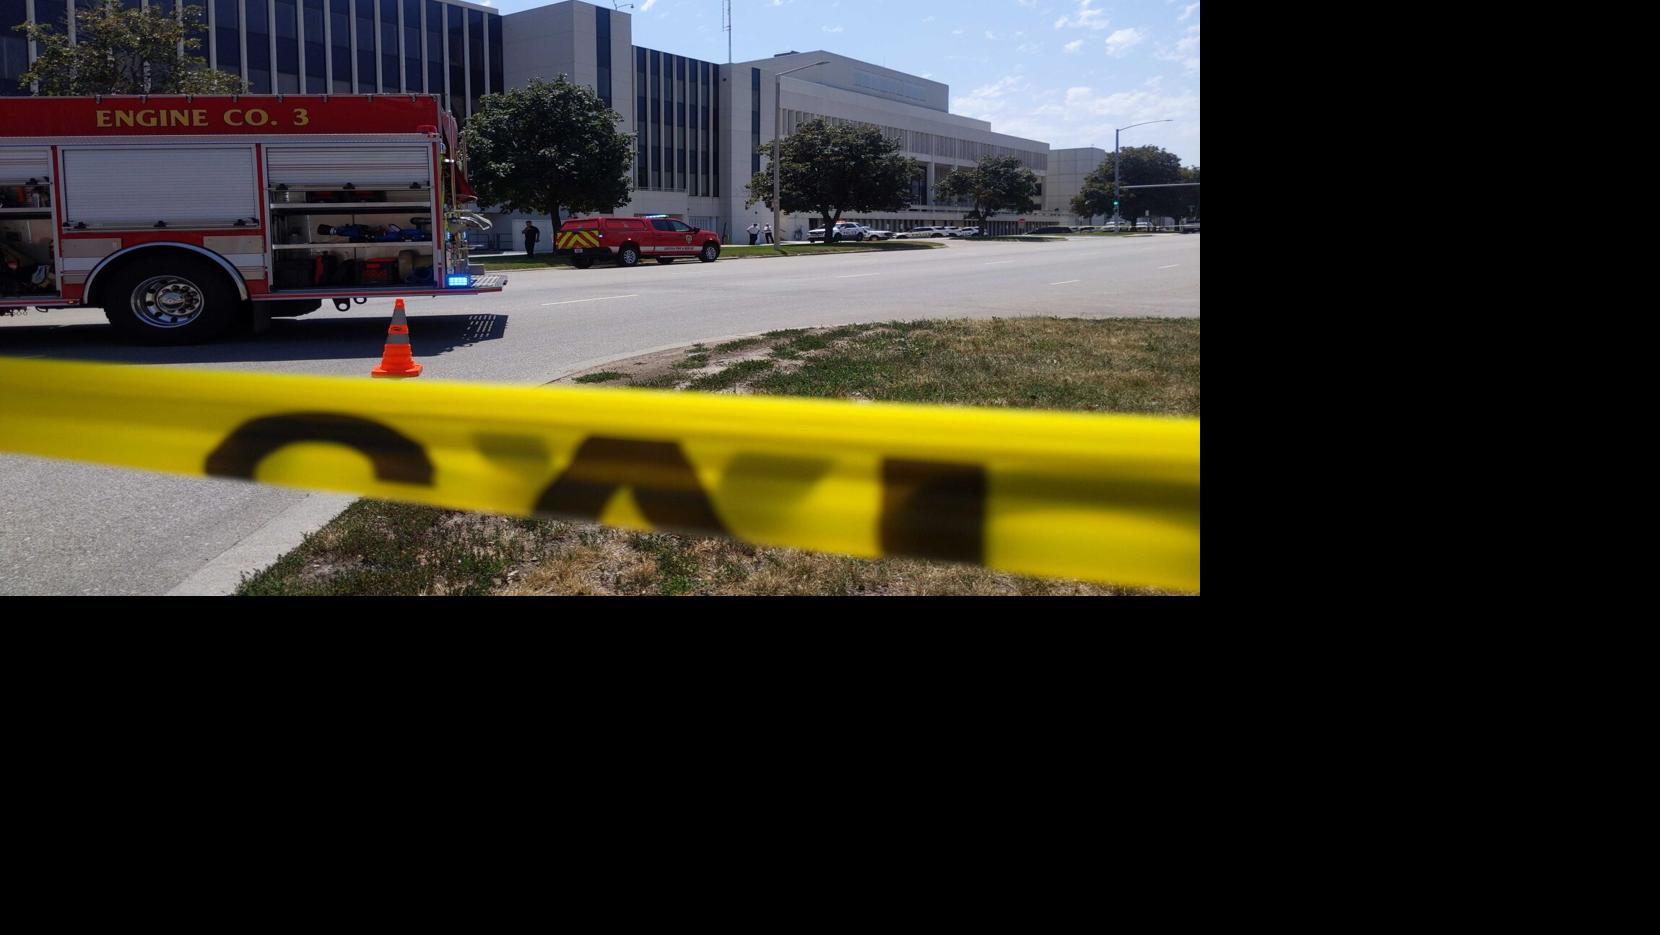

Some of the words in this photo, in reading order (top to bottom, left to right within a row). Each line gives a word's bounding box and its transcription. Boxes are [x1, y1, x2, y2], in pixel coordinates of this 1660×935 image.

[96, 109, 208, 127] ENGINE
[223, 108, 278, 126] CO.
[293, 108, 309, 126] 3
